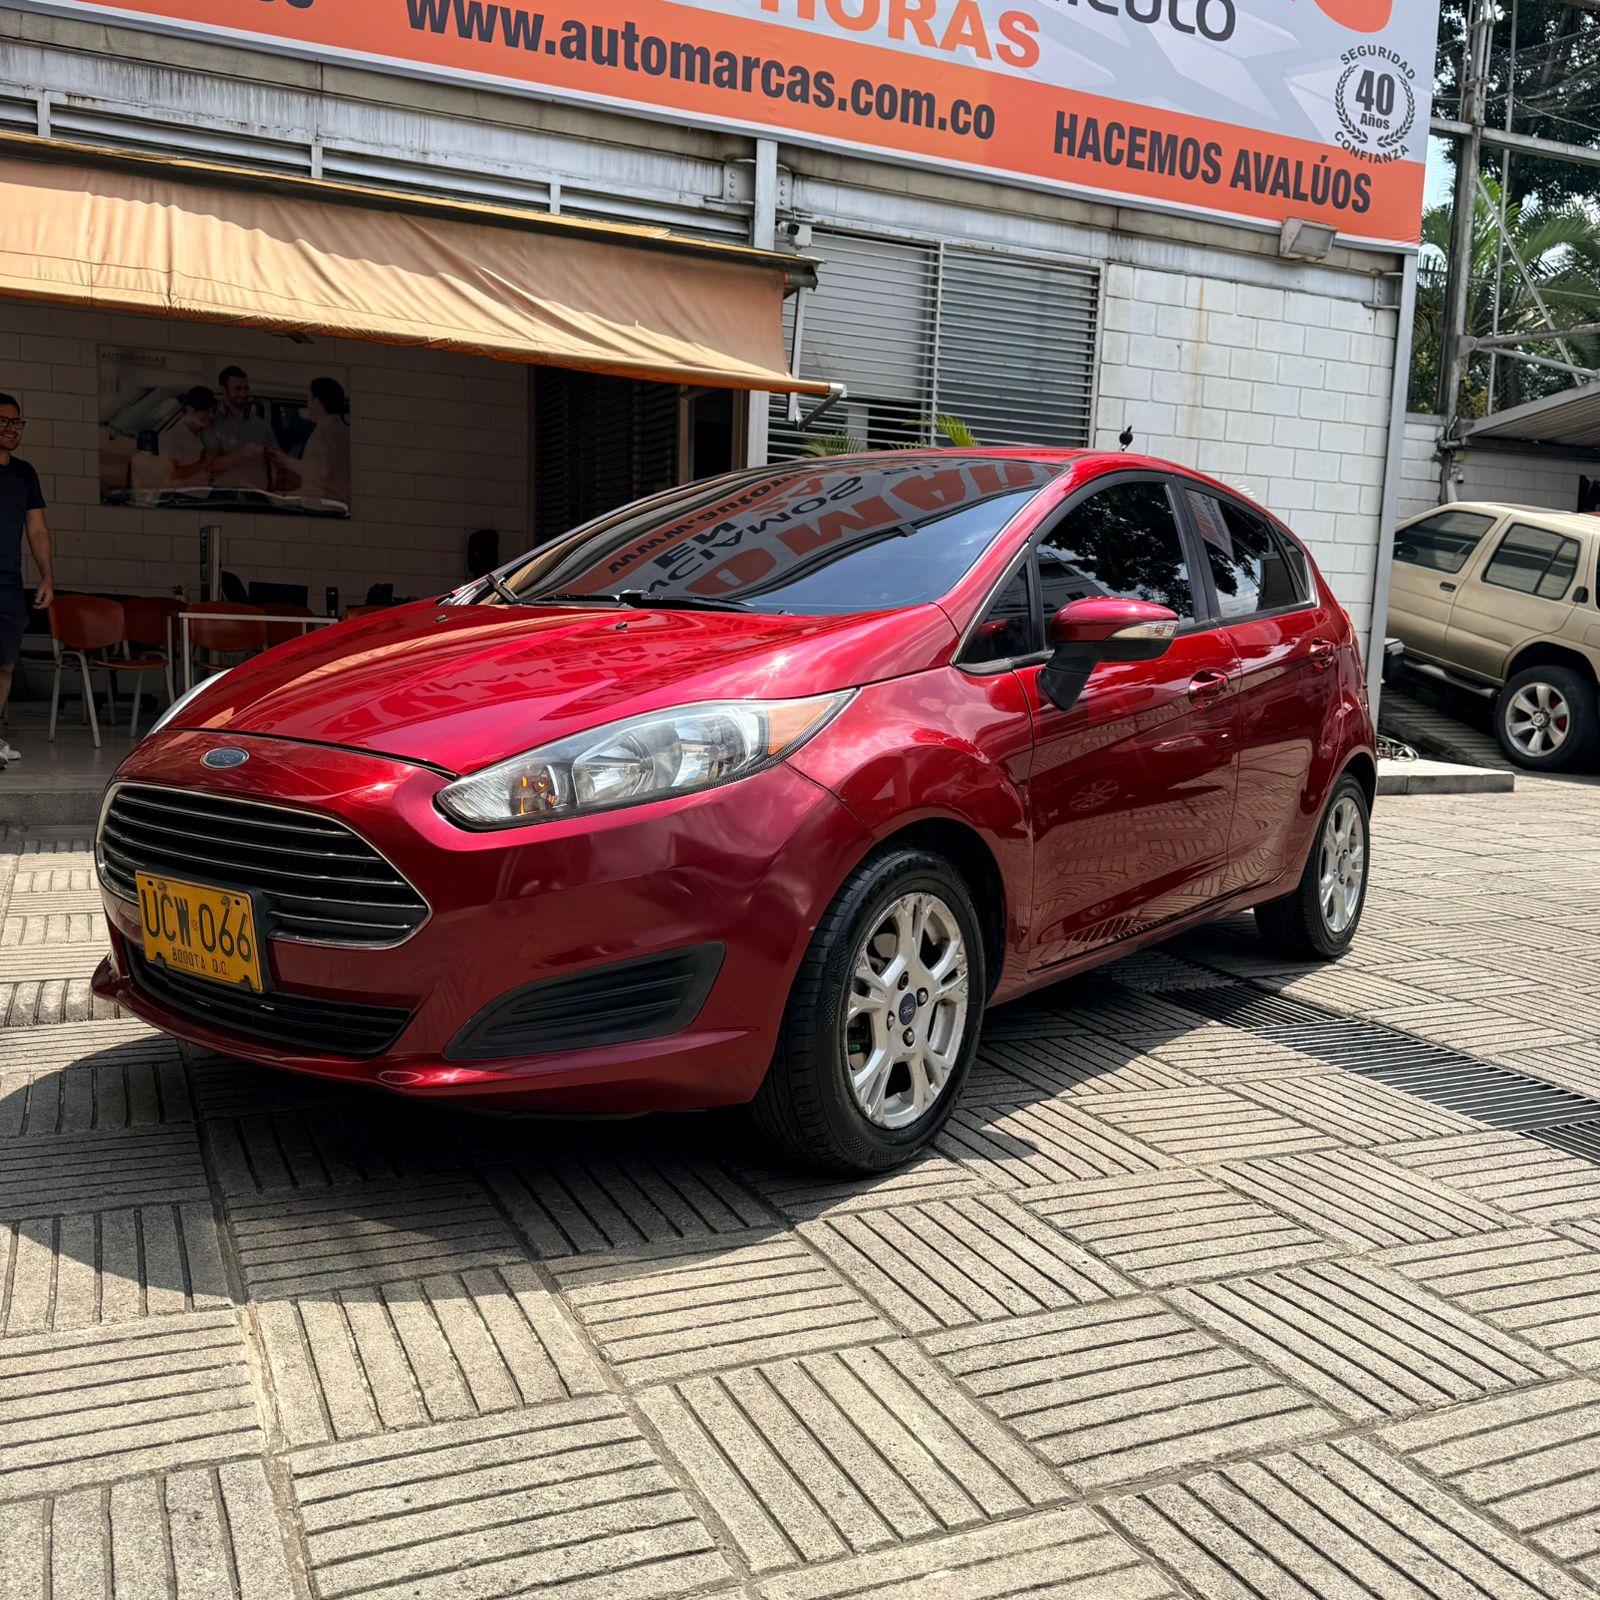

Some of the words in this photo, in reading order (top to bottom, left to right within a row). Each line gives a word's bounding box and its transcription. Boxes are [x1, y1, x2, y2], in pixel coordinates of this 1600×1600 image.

[406, 0, 995, 139] www.automarcas.com.co
[1340, 44, 1416, 80] SEGURIDAD
[1355, 69, 1396, 116] 40
[1359, 112, 1391, 131] Años
[1053, 110, 1222, 185] HACEMOS
[1229, 148, 1372, 213] AVALÚOS
[1334, 130, 1410, 164] CONFIANZA
[141, 889, 192, 947] UCW
[199, 903, 251, 962] 066
